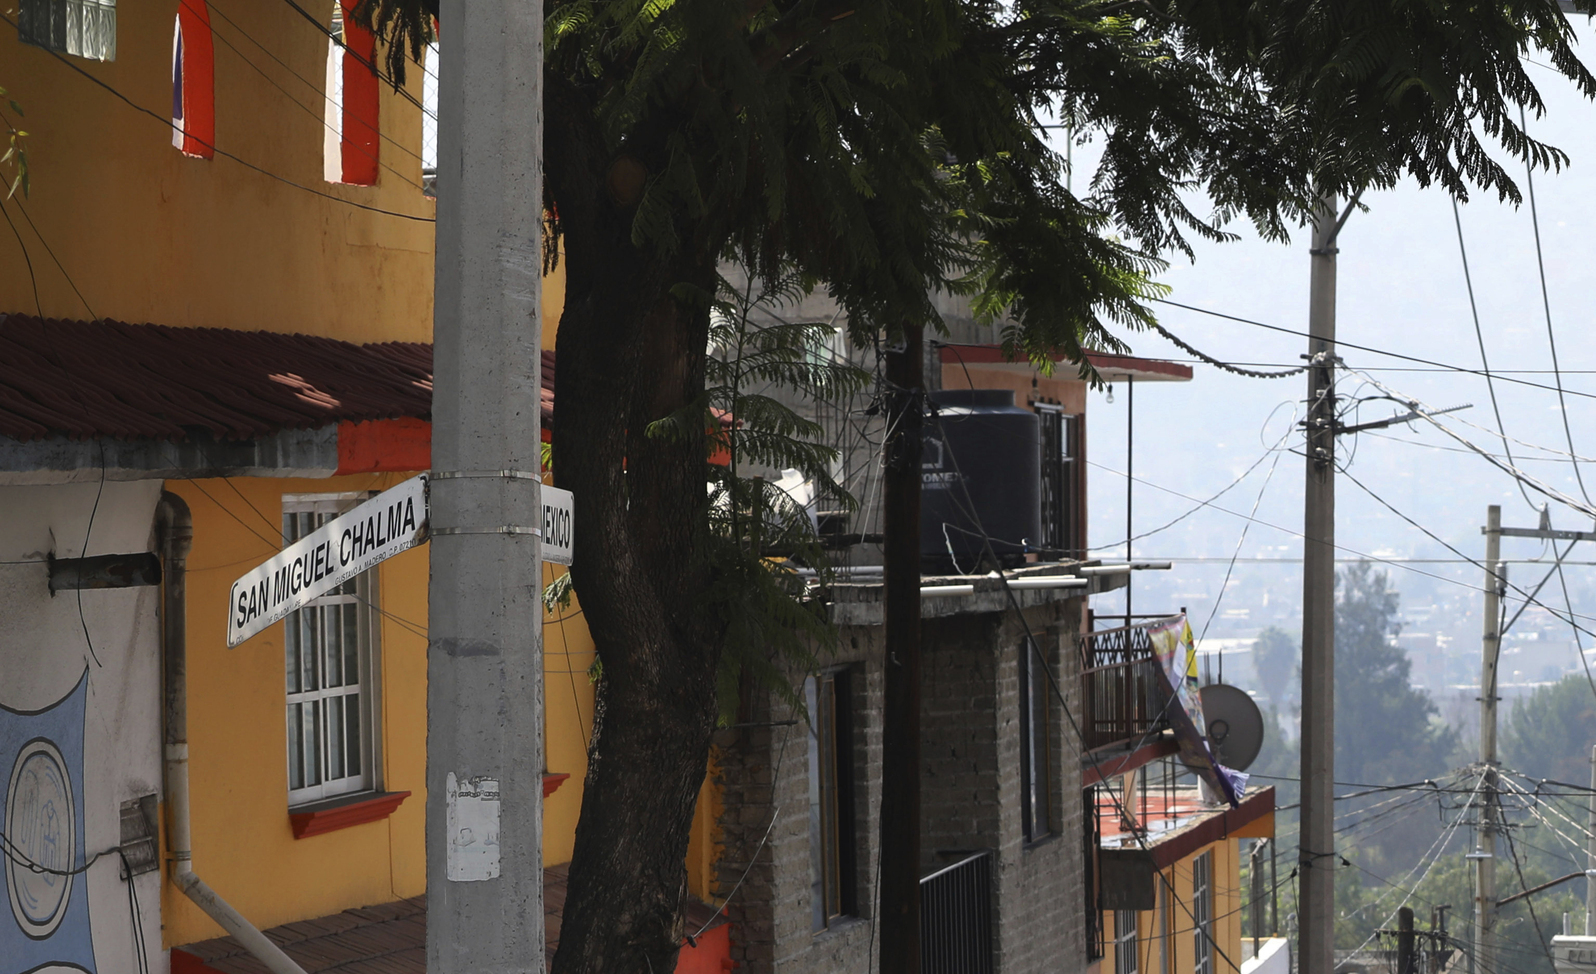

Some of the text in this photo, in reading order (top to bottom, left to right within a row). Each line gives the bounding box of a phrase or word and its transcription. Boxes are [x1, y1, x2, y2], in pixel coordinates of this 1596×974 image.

[237, 496, 416, 628] SAN MIGUEL CHALMA
[335, 567, 358, 586] GUSTAVO
[364, 553, 387, 569] MADERO
